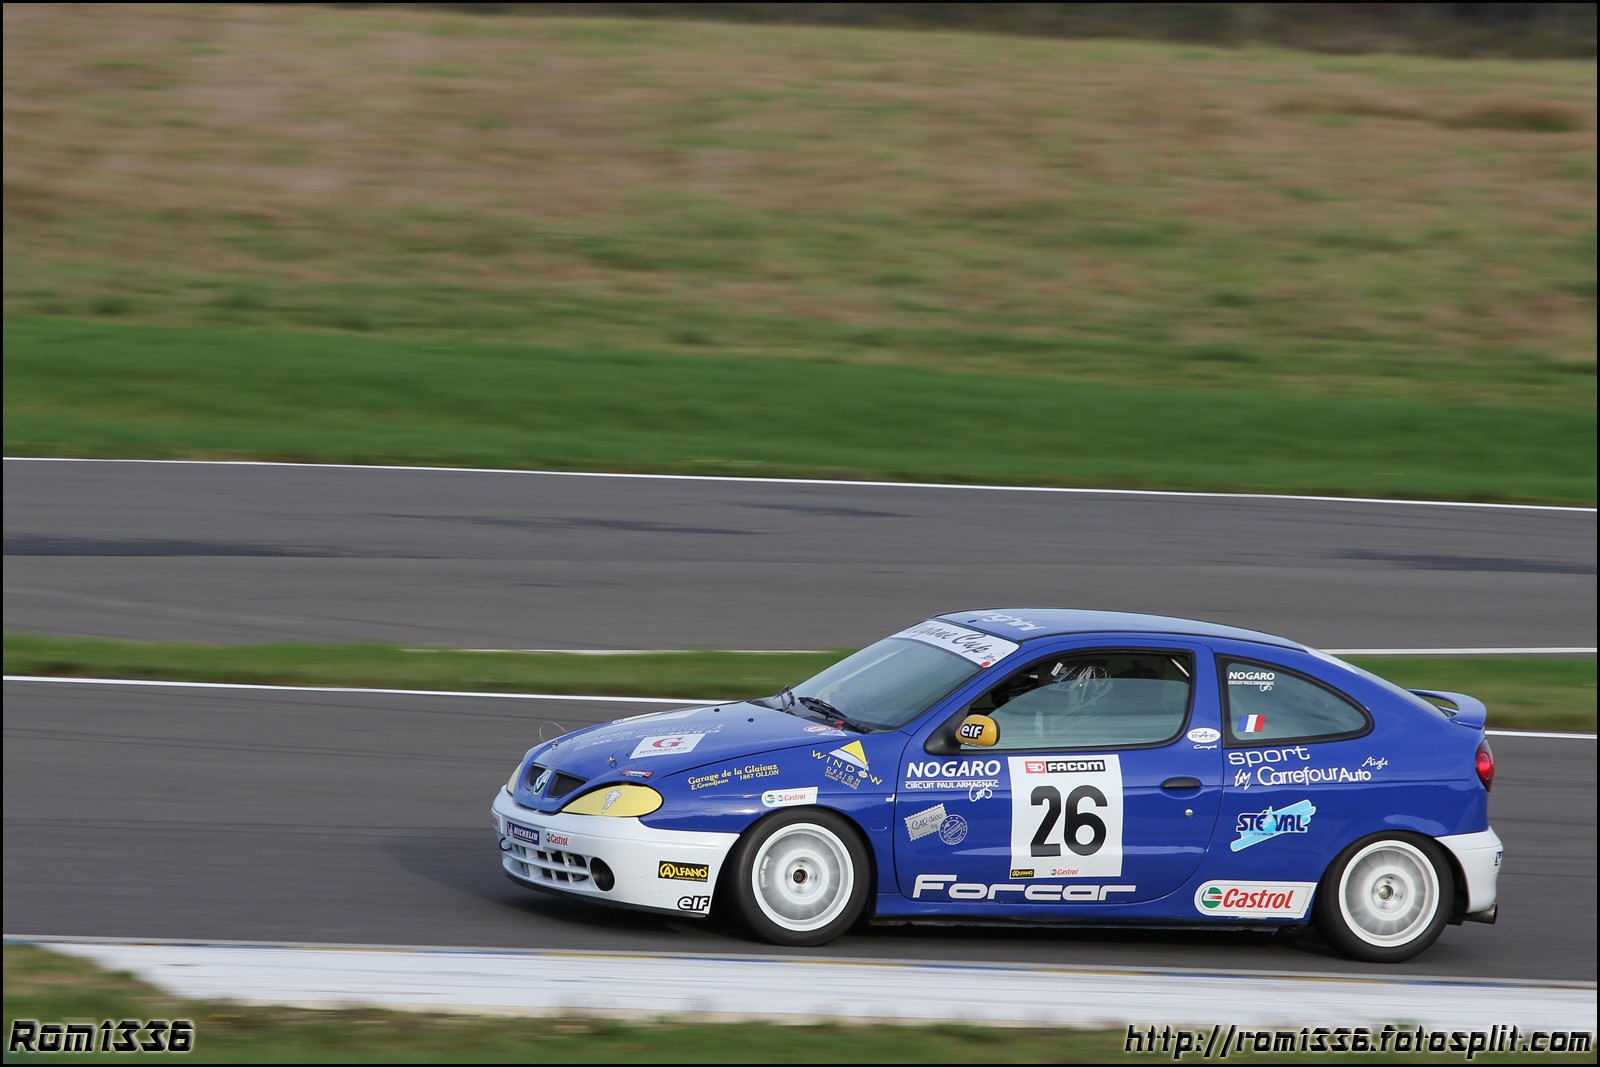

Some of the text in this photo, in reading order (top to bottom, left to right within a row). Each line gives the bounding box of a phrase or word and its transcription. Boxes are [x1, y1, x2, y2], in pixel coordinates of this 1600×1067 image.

[951, 633, 995, 654] Cup
[1227, 671, 1275, 681] NOGARO
[960, 724, 984, 739] elf
[1228, 746, 1310, 767] sport
[1362, 757, 1389, 770] Aigle
[687, 764, 778, 785] Garage de la Glaivaz
[740, 769, 779, 781] 1867 OLLON
[812, 749, 883, 785] WINDOW
[906, 760, 1001, 778] NOGARO
[1046, 761, 1106, 773] FACOM
[1234, 769, 1251, 790] by
[784, 793, 807, 802] Castrol
[1030, 785, 1108, 858] 26
[513, 827, 539, 841] MICHELIN
[551, 834, 569, 846] Castrol
[912, 874, 1136, 901] Forcar
[678, 896, 710, 911] elf
[1223, 888, 1294, 909] Castrol
